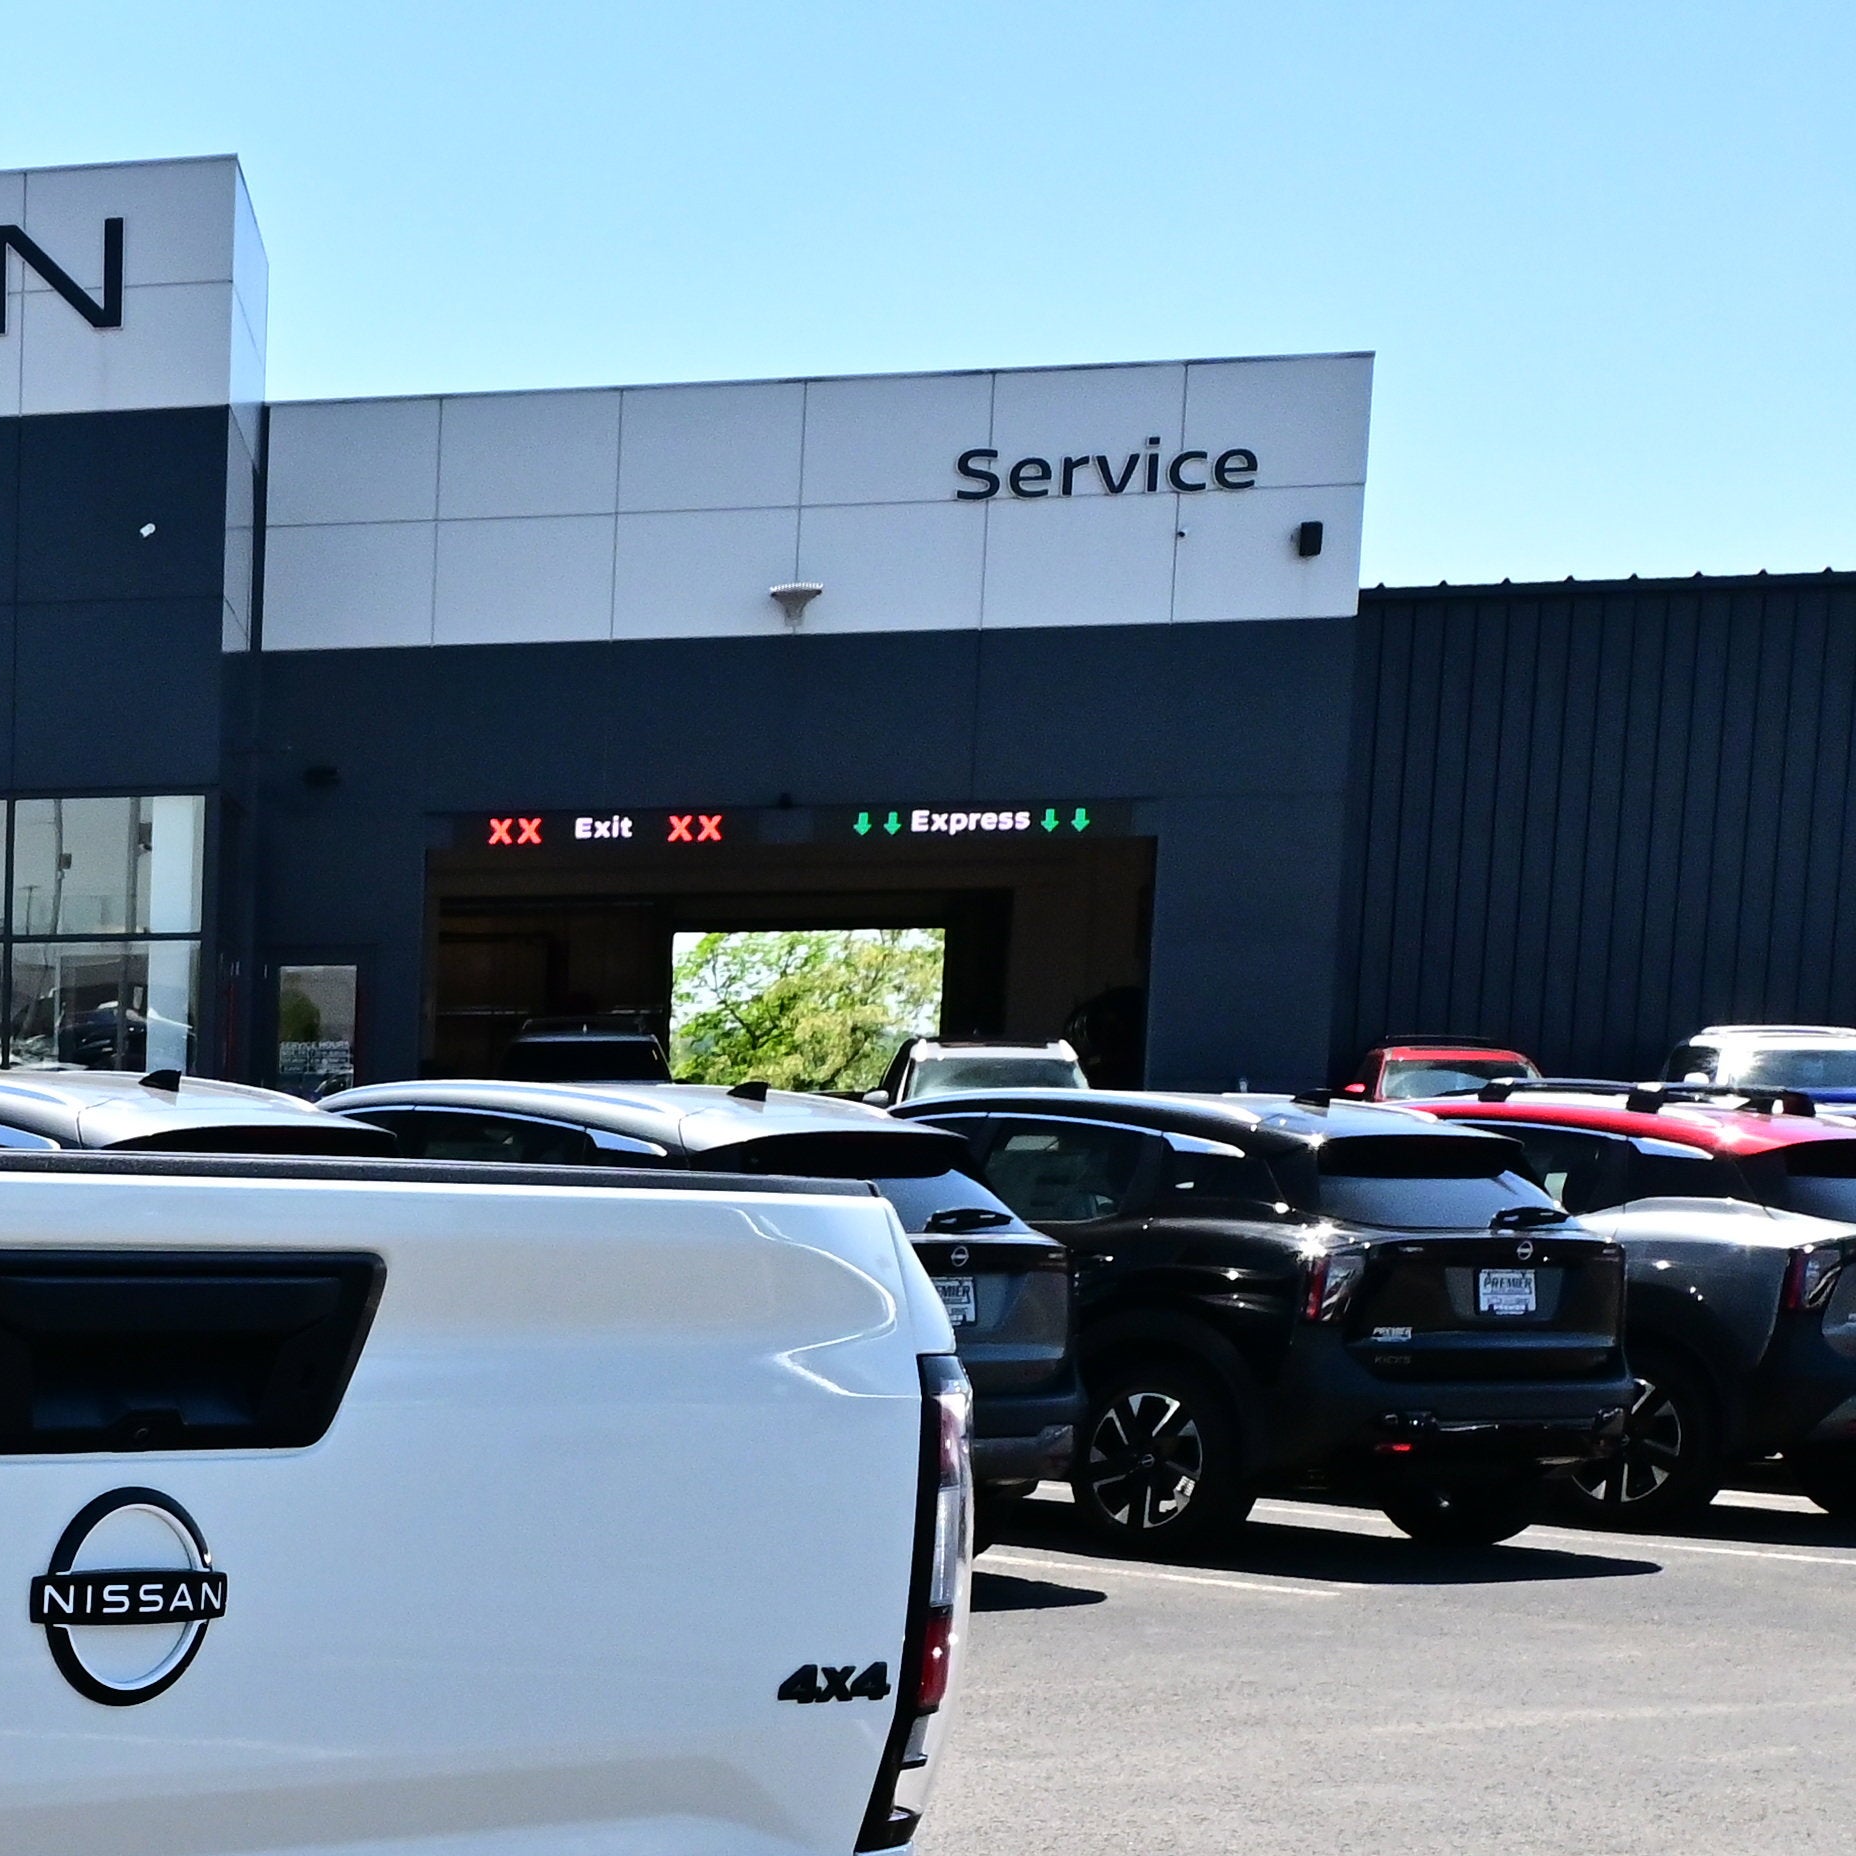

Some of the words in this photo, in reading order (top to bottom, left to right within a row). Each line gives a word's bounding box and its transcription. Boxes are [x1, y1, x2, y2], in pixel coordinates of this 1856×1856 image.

[955, 436, 1259, 500] Service
[575, 815, 633, 840] Exit
[911, 809, 1031, 836] Express
[1483, 1276, 1533, 1292] PREMIER
[43, 1581, 222, 1614] NISSAN
